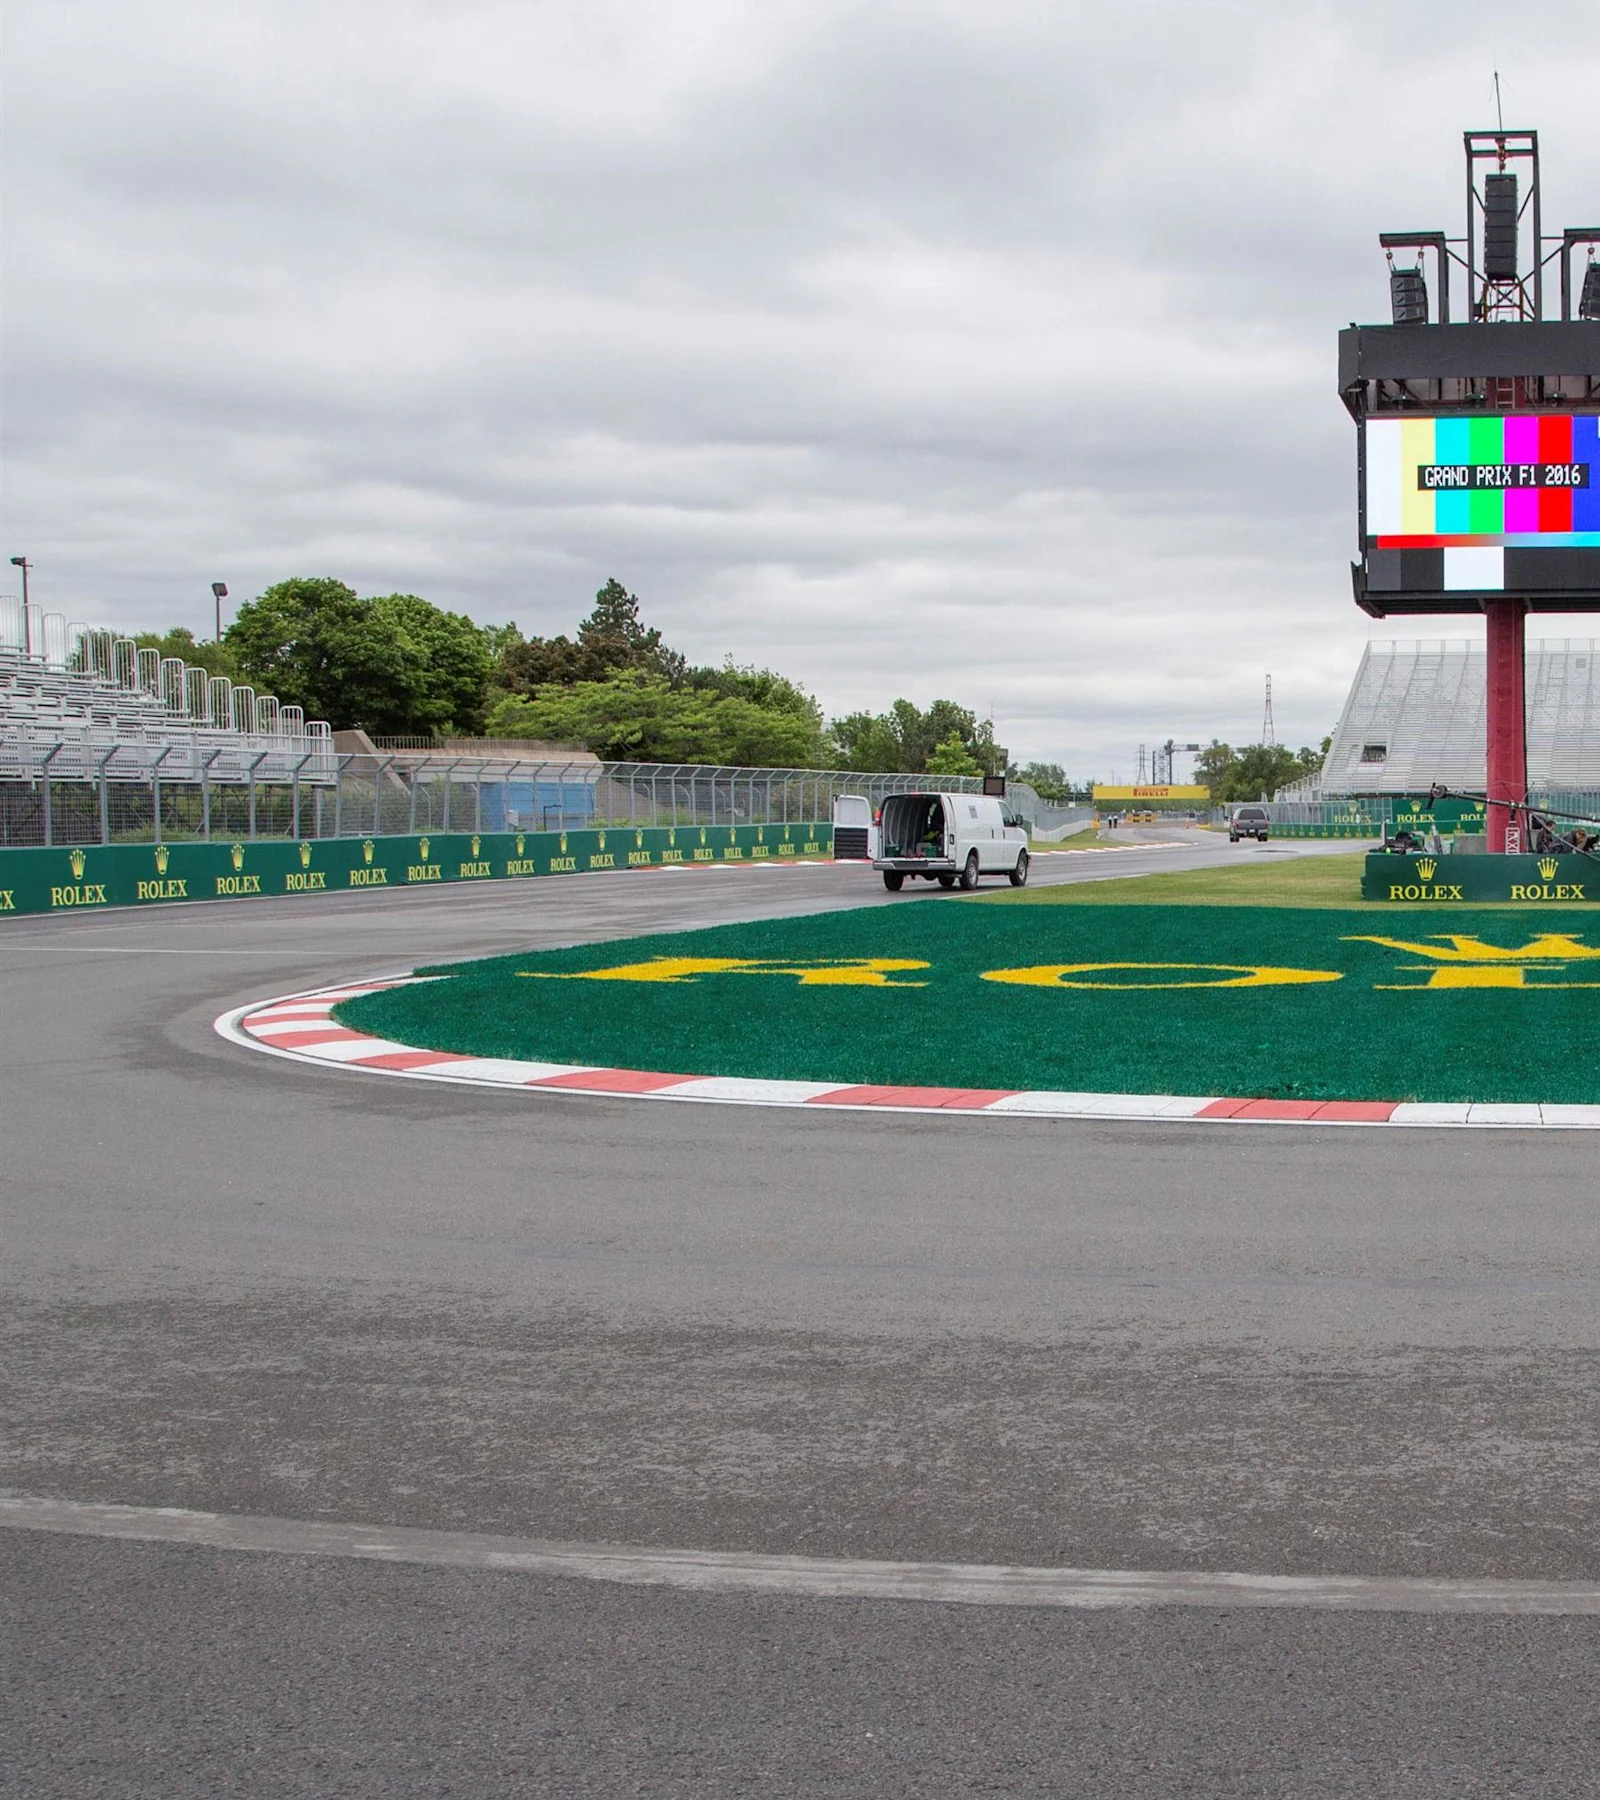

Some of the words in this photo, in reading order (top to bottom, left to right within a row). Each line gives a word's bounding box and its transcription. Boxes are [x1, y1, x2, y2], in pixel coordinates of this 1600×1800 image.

[1425, 467, 1469, 488] GRAND
[1476, 466, 1512, 487] PRIX
[1519, 466, 1537, 486] F1
[1546, 465, 1581, 486] 2016
[1133, 788, 1169, 797] PIRELLI
[1396, 814, 1436, 823] ROLEX
[628, 851, 651, 864] ROLEX
[662, 850, 683, 862] ROLEX
[694, 848, 713, 860] ROLEX
[724, 847, 743, 859] ROLEX
[507, 860, 534, 874] ROLEX
[550, 857, 575, 872] ROLEX
[590, 854, 614, 868] ROLEX
[350, 868, 387, 886] ROLEX
[408, 864, 441, 880] ROLEX
[461, 862, 490, 877] ROLEX
[137, 879, 188, 899] ROLEX
[216, 875, 261, 894] ROLEX
[286, 873, 325, 890] ROLEX
[51, 885, 107, 906] ROLEX
[1389, 885, 1463, 900] ROLEX
[1511, 885, 1585, 900] ROLEX
